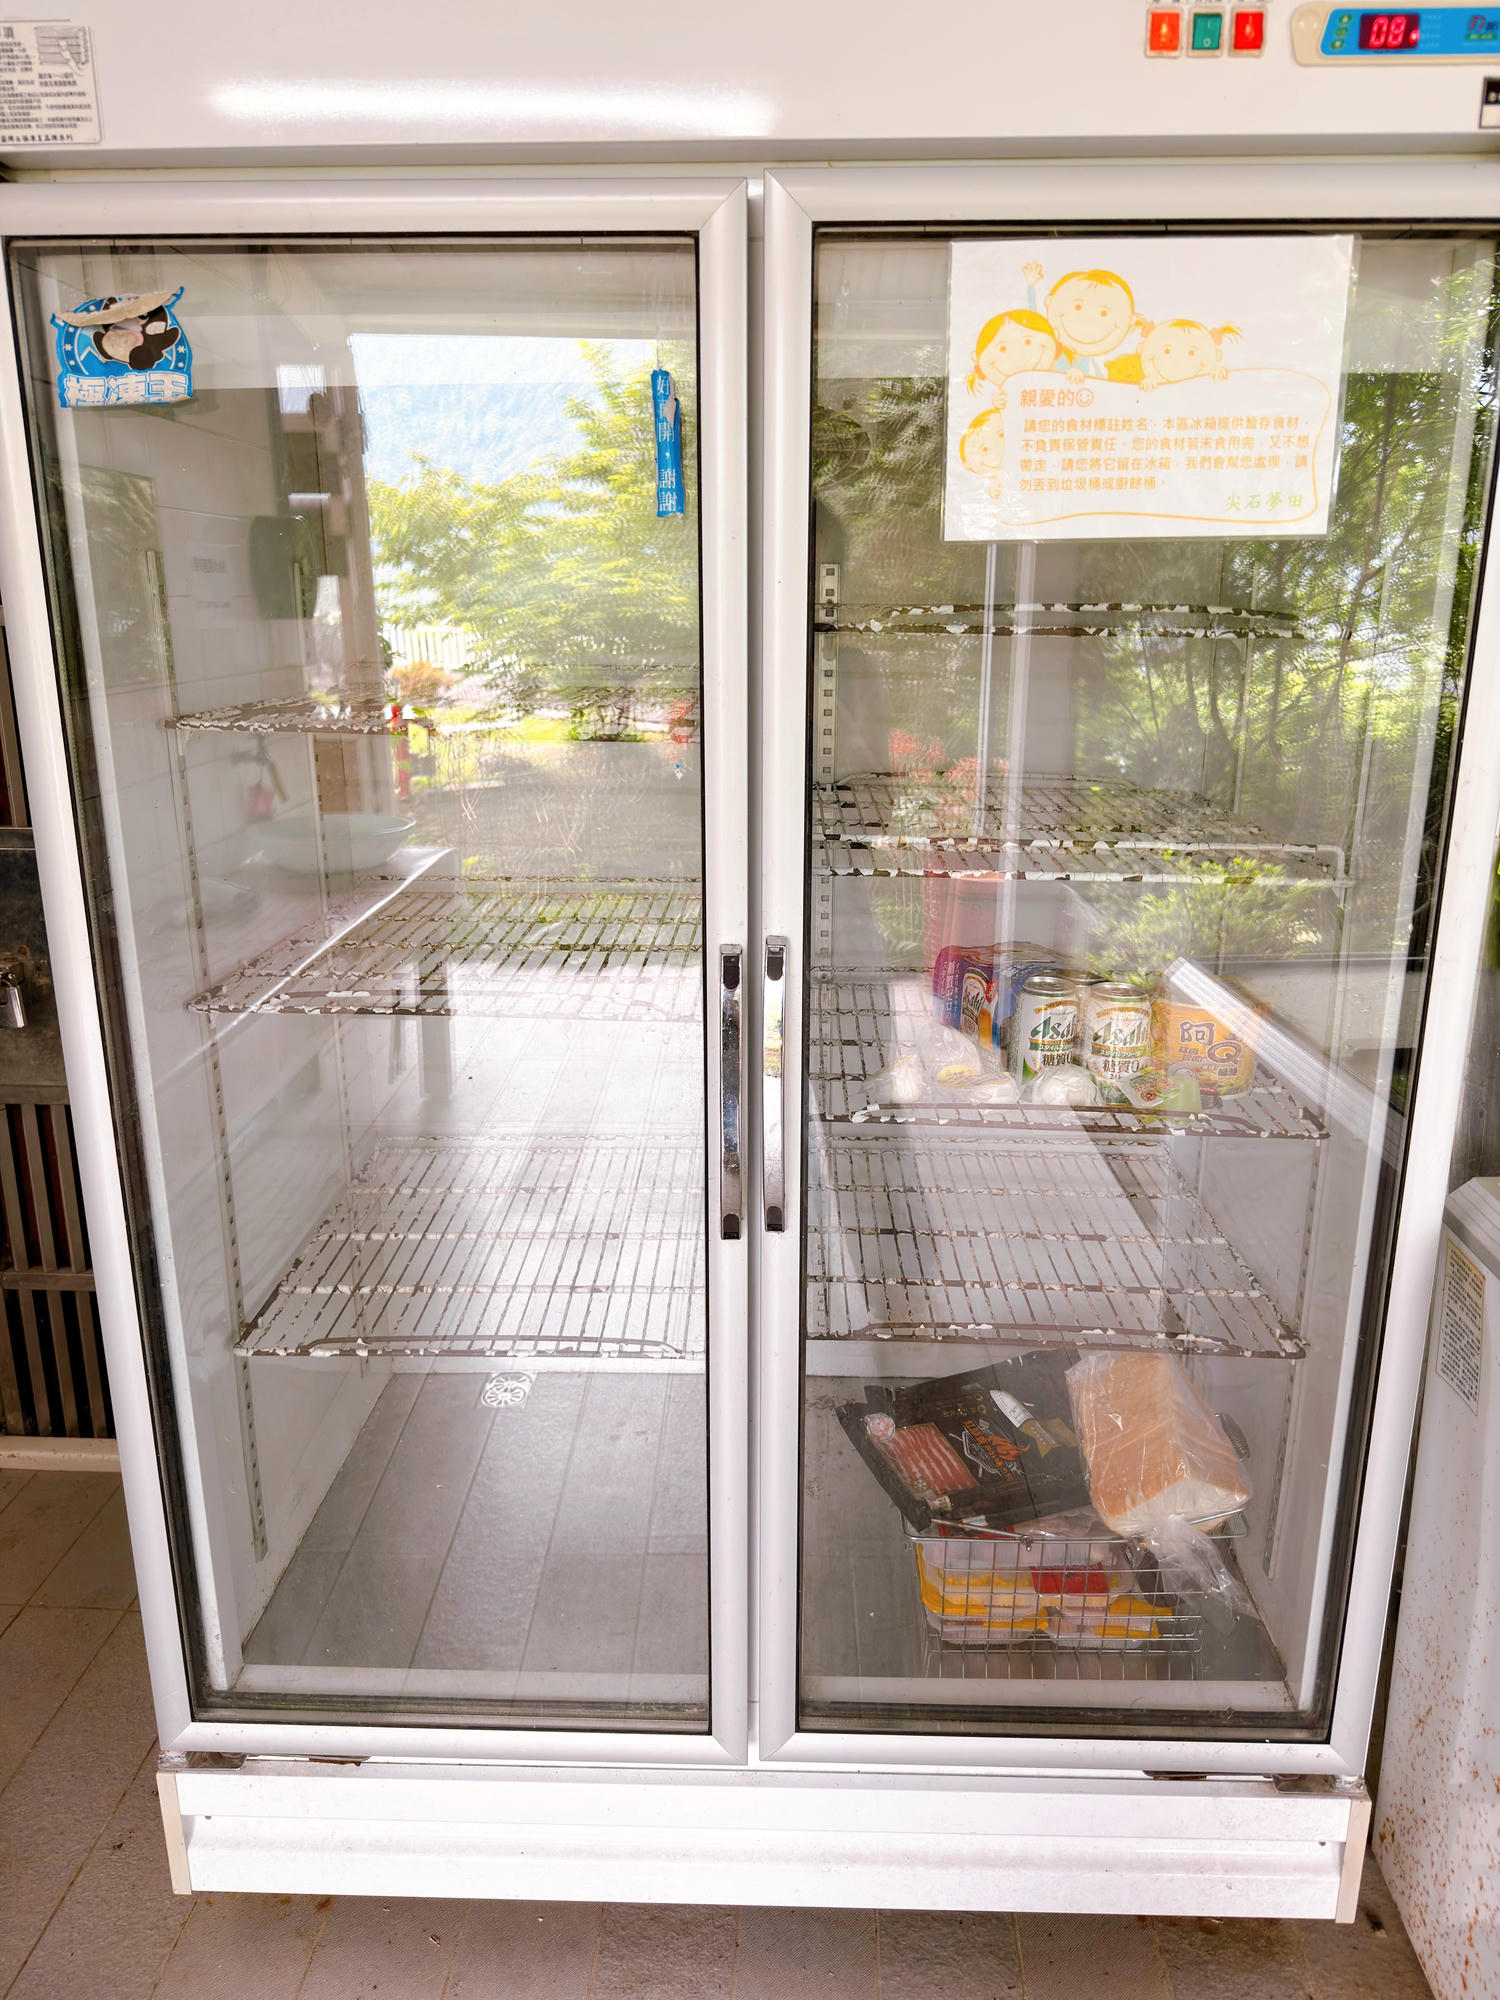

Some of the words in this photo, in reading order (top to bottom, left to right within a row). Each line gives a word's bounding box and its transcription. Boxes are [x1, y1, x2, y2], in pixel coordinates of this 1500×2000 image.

[1020, 388, 1075, 408] 親愛的
[1225, 491, 1304, 512] 尖石夢田
